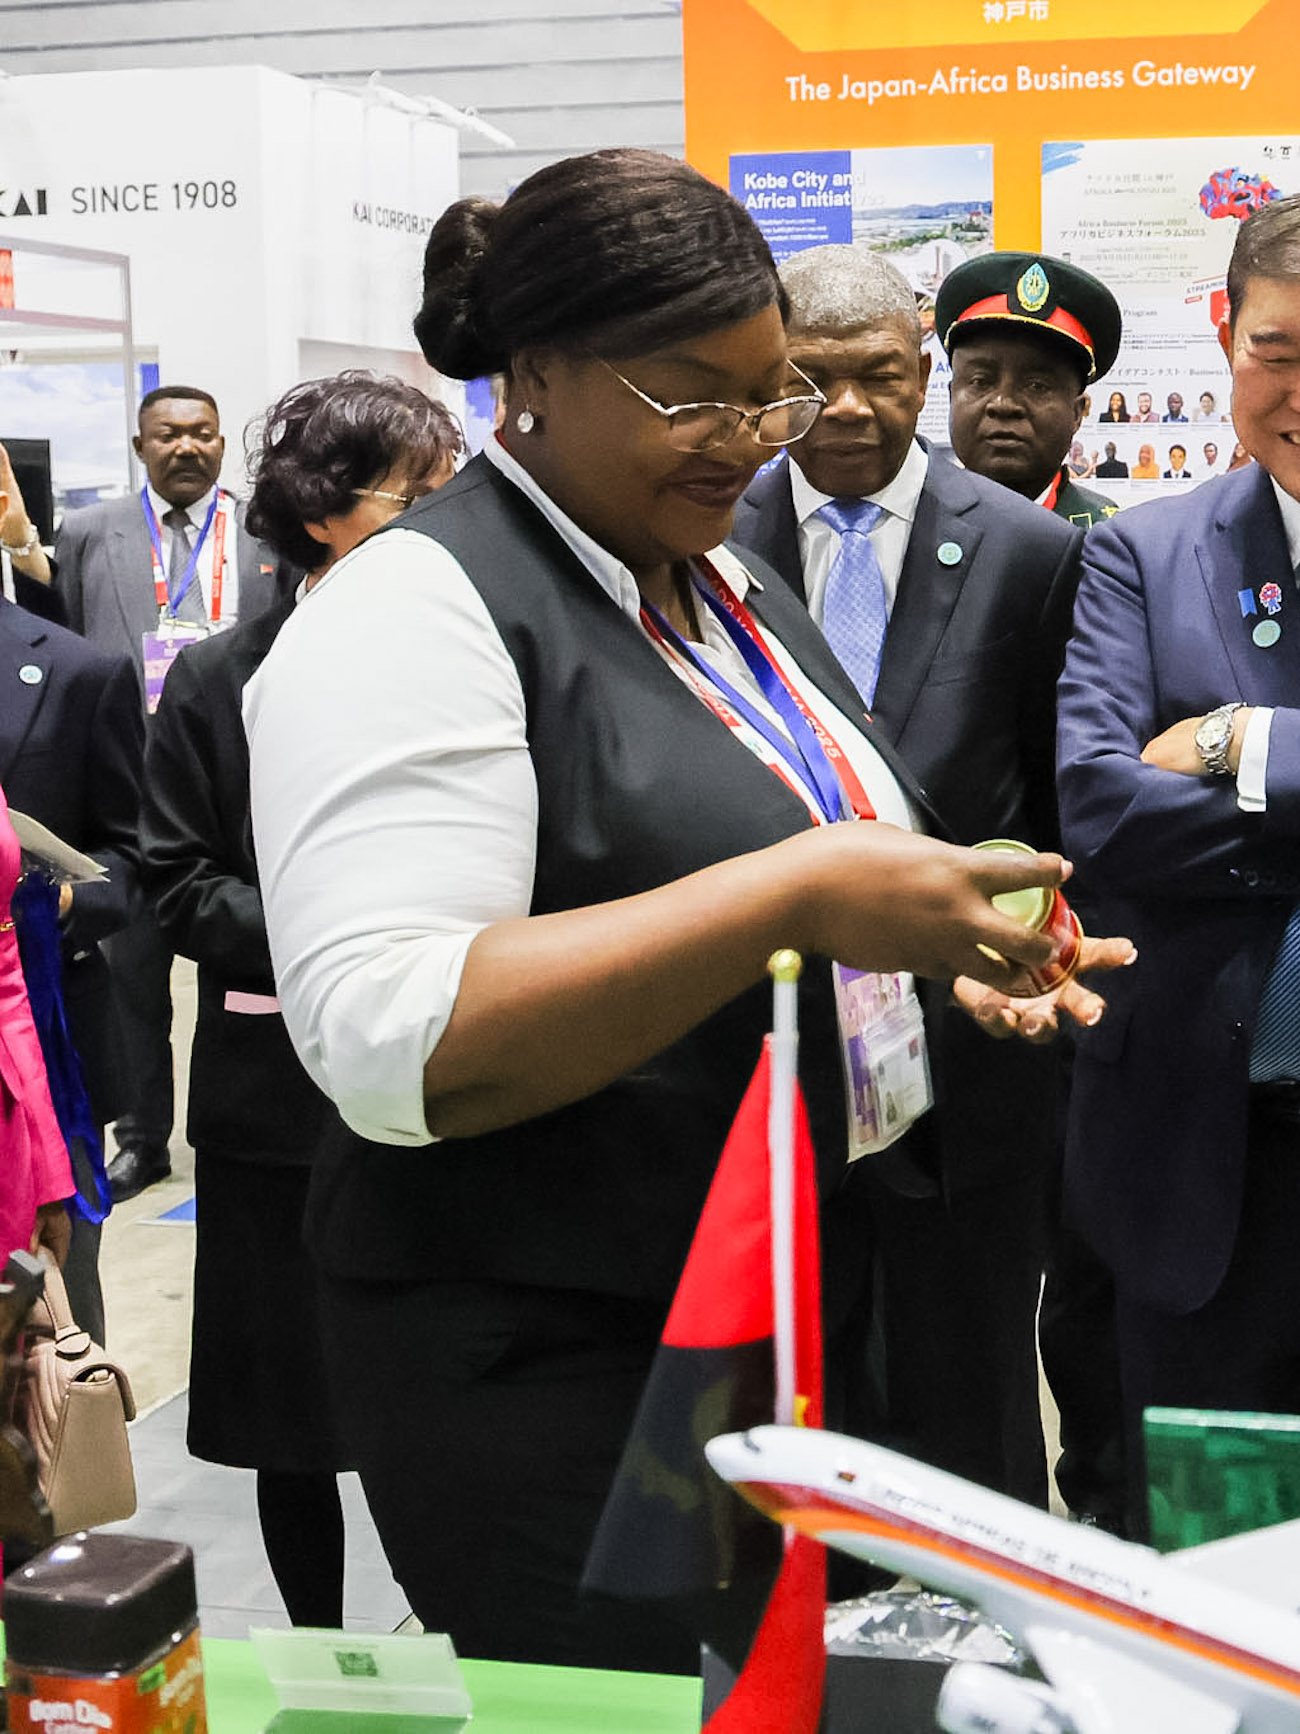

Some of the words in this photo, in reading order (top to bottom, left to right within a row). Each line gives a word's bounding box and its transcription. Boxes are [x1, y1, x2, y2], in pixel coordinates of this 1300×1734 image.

[983, 0, 1050, 23] 神戸市
[785, 75, 831, 101] The
[837, 67, 1009, 105] Japan-Africa
[1017, 65, 1124, 91] Business
[1132, 60, 1256, 90] Gateway
[744, 172, 788, 190] Kobe
[792, 170, 828, 191] City
[833, 168, 864, 187] and
[71, 184, 158, 214] SINCE
[173, 180, 237, 210] 1908
[745, 192, 797, 210] Africa
[353, 202, 372, 224] KAI
